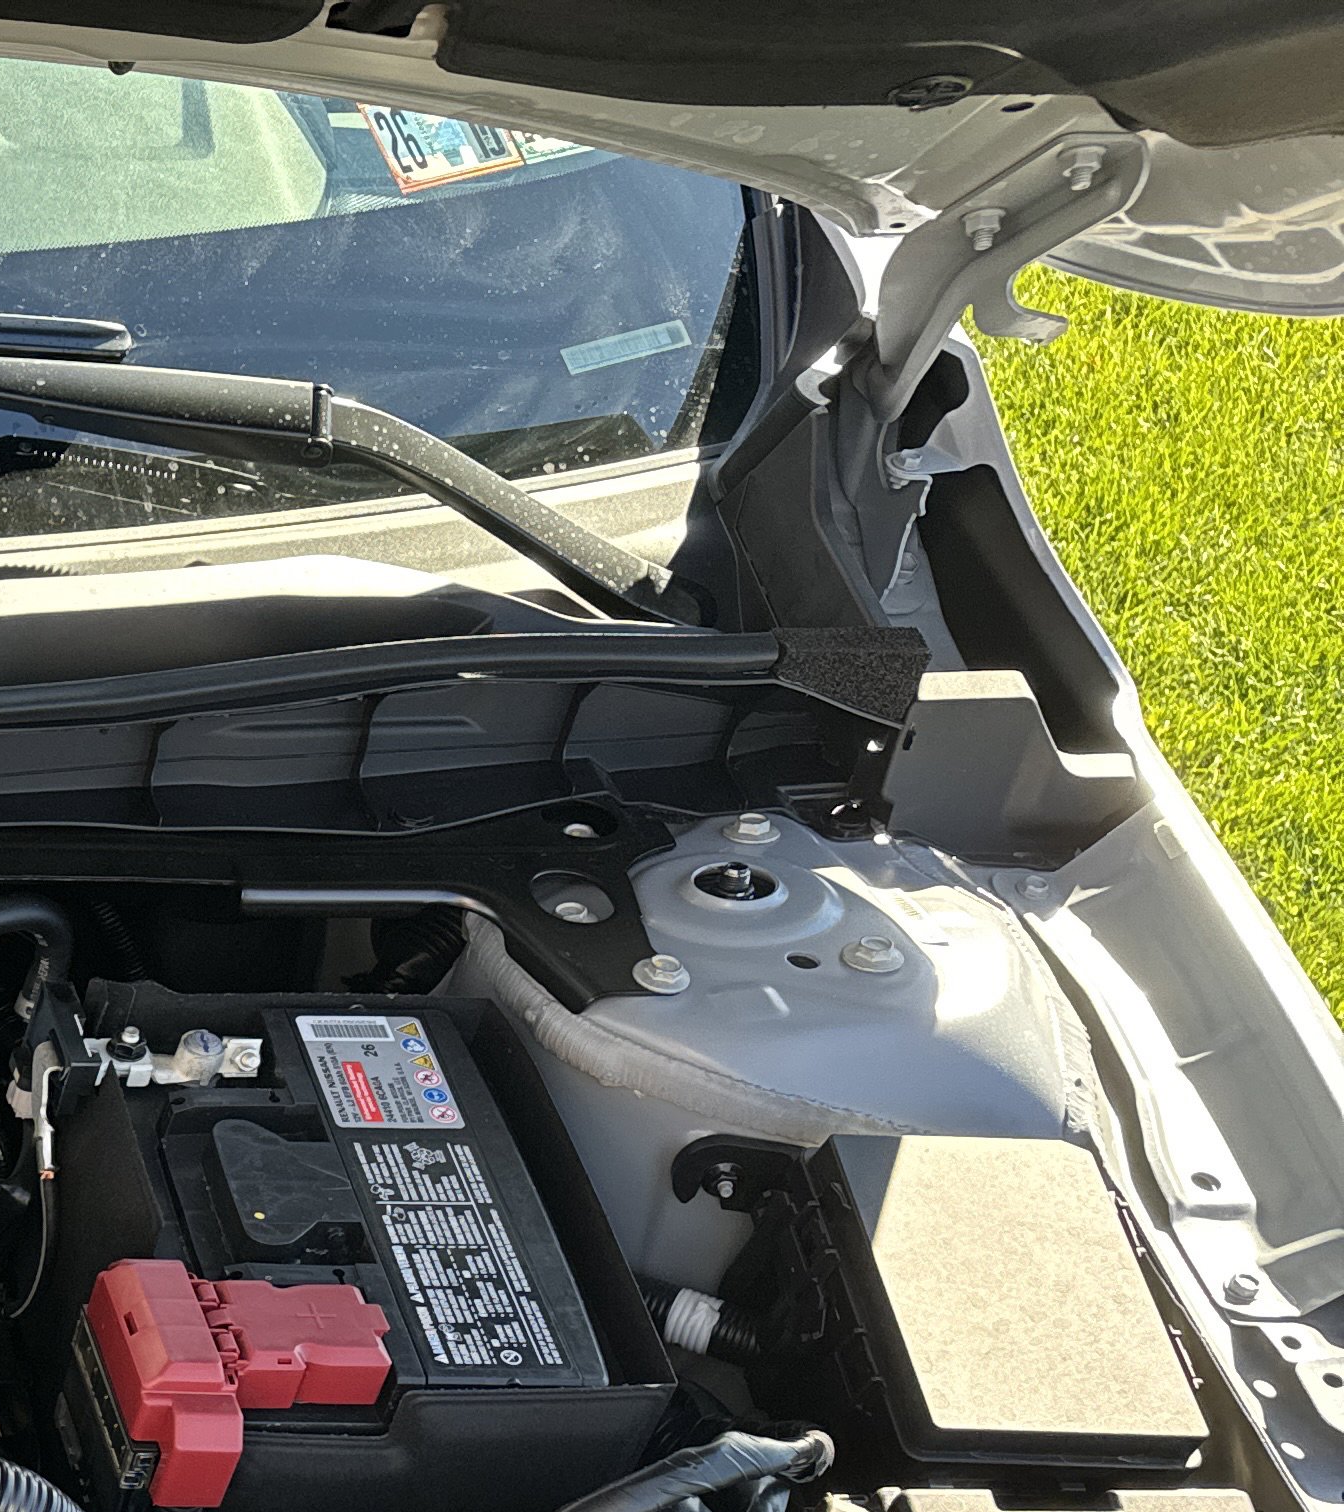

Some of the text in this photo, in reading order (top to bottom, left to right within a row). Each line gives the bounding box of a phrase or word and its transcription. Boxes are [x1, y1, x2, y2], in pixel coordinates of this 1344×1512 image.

[374, 107, 428, 174] 26
[361, 1044, 378, 1057] 26
[317, 1055, 337, 1088] NISSAN
